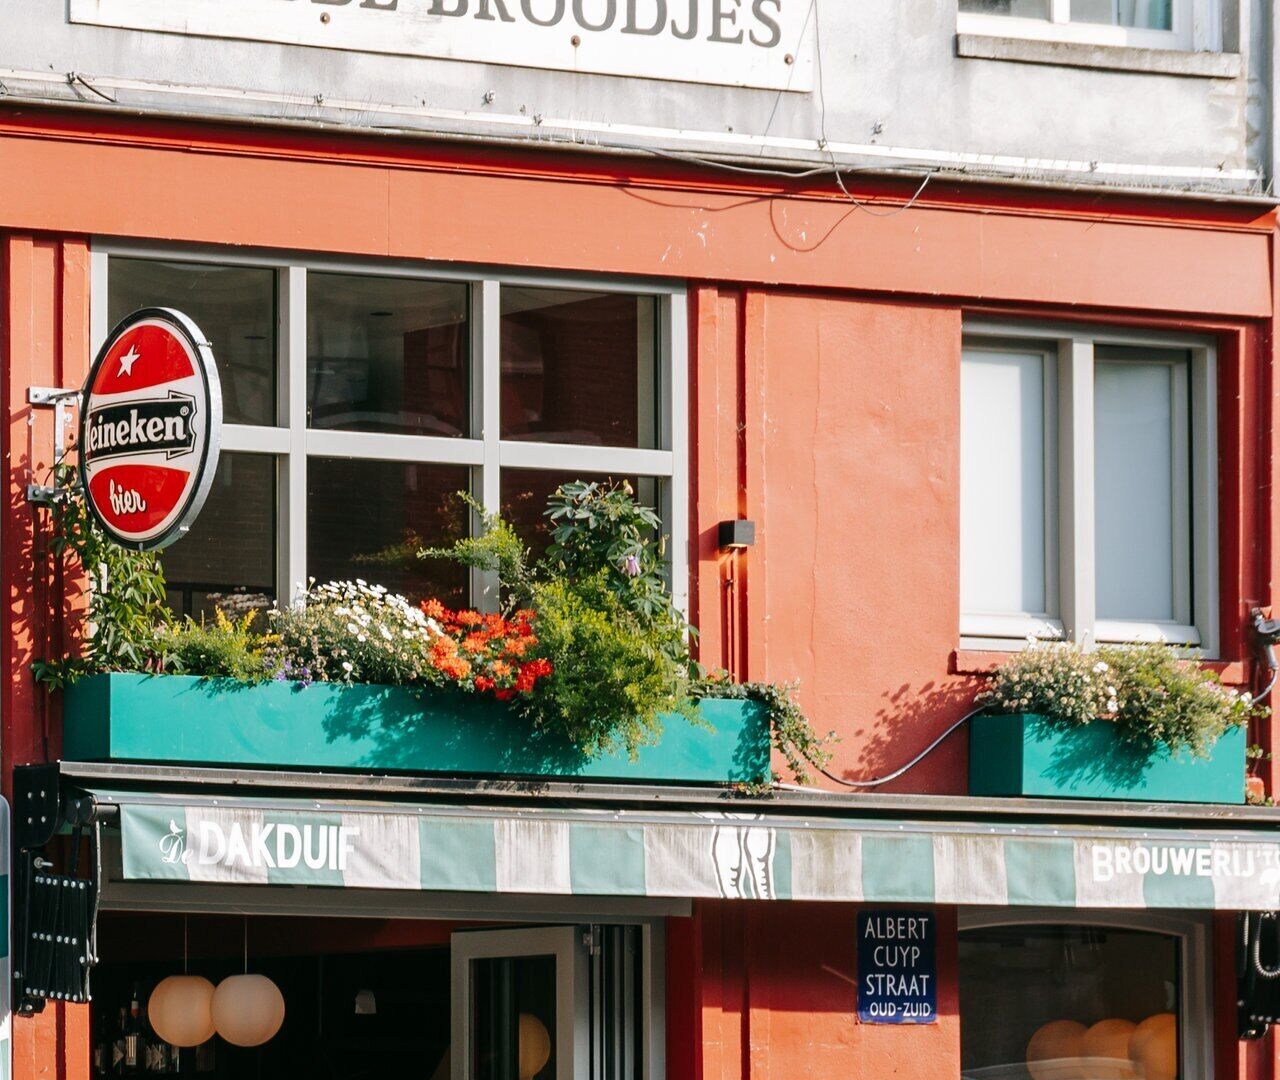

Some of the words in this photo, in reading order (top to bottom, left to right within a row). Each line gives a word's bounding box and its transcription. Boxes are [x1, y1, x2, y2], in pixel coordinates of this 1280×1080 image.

[109, 478, 146, 516] bier
[158, 833, 194, 865] De
[197, 820, 360, 871] DAKDUIF
[1092, 845, 1255, 882] BROUWERIJ
[864, 916, 929, 940] ALBERT
[873, 945, 921, 968] CUYP
[865, 974, 930, 997] STRAAT
[869, 1001, 931, 1018] OUD-ZUID
